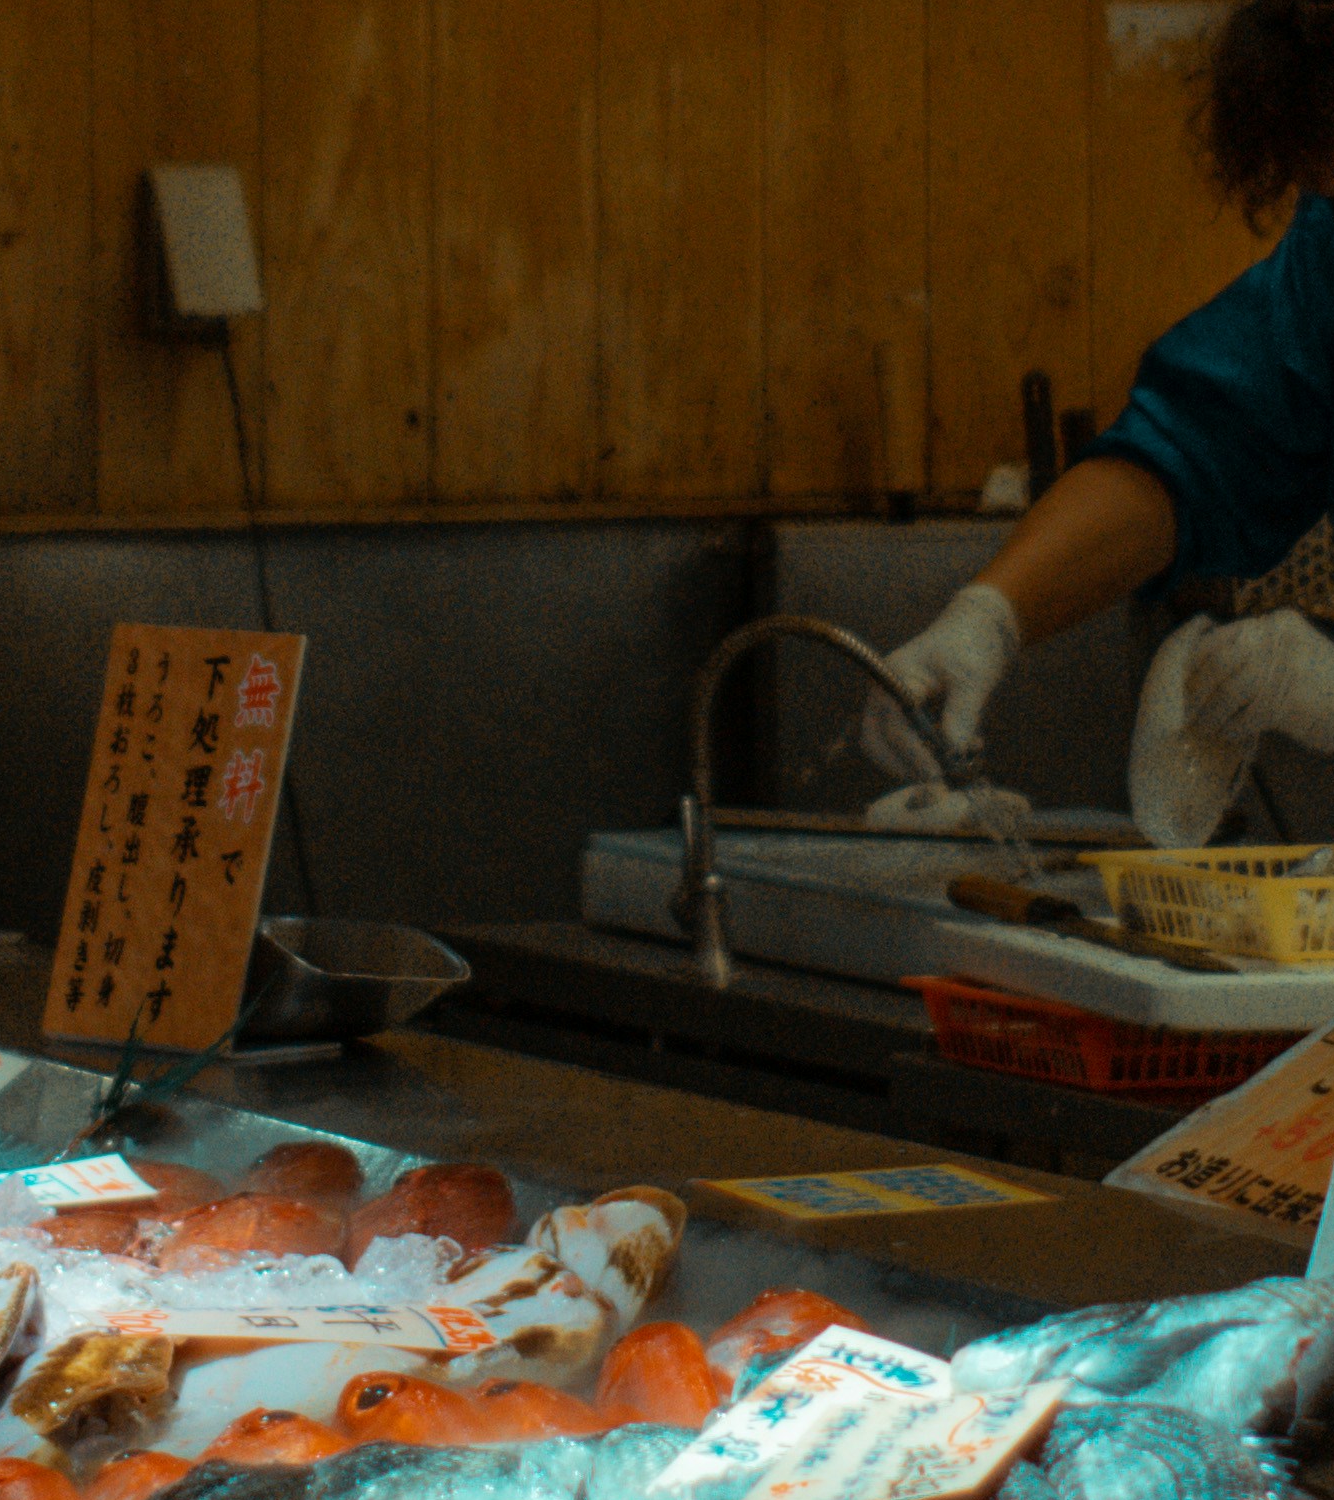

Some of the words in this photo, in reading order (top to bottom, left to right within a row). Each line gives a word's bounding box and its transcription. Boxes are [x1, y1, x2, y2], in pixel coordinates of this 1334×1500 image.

[147, 655, 230, 1023] 下処理承ります
[218, 652, 283, 885] 無料で
